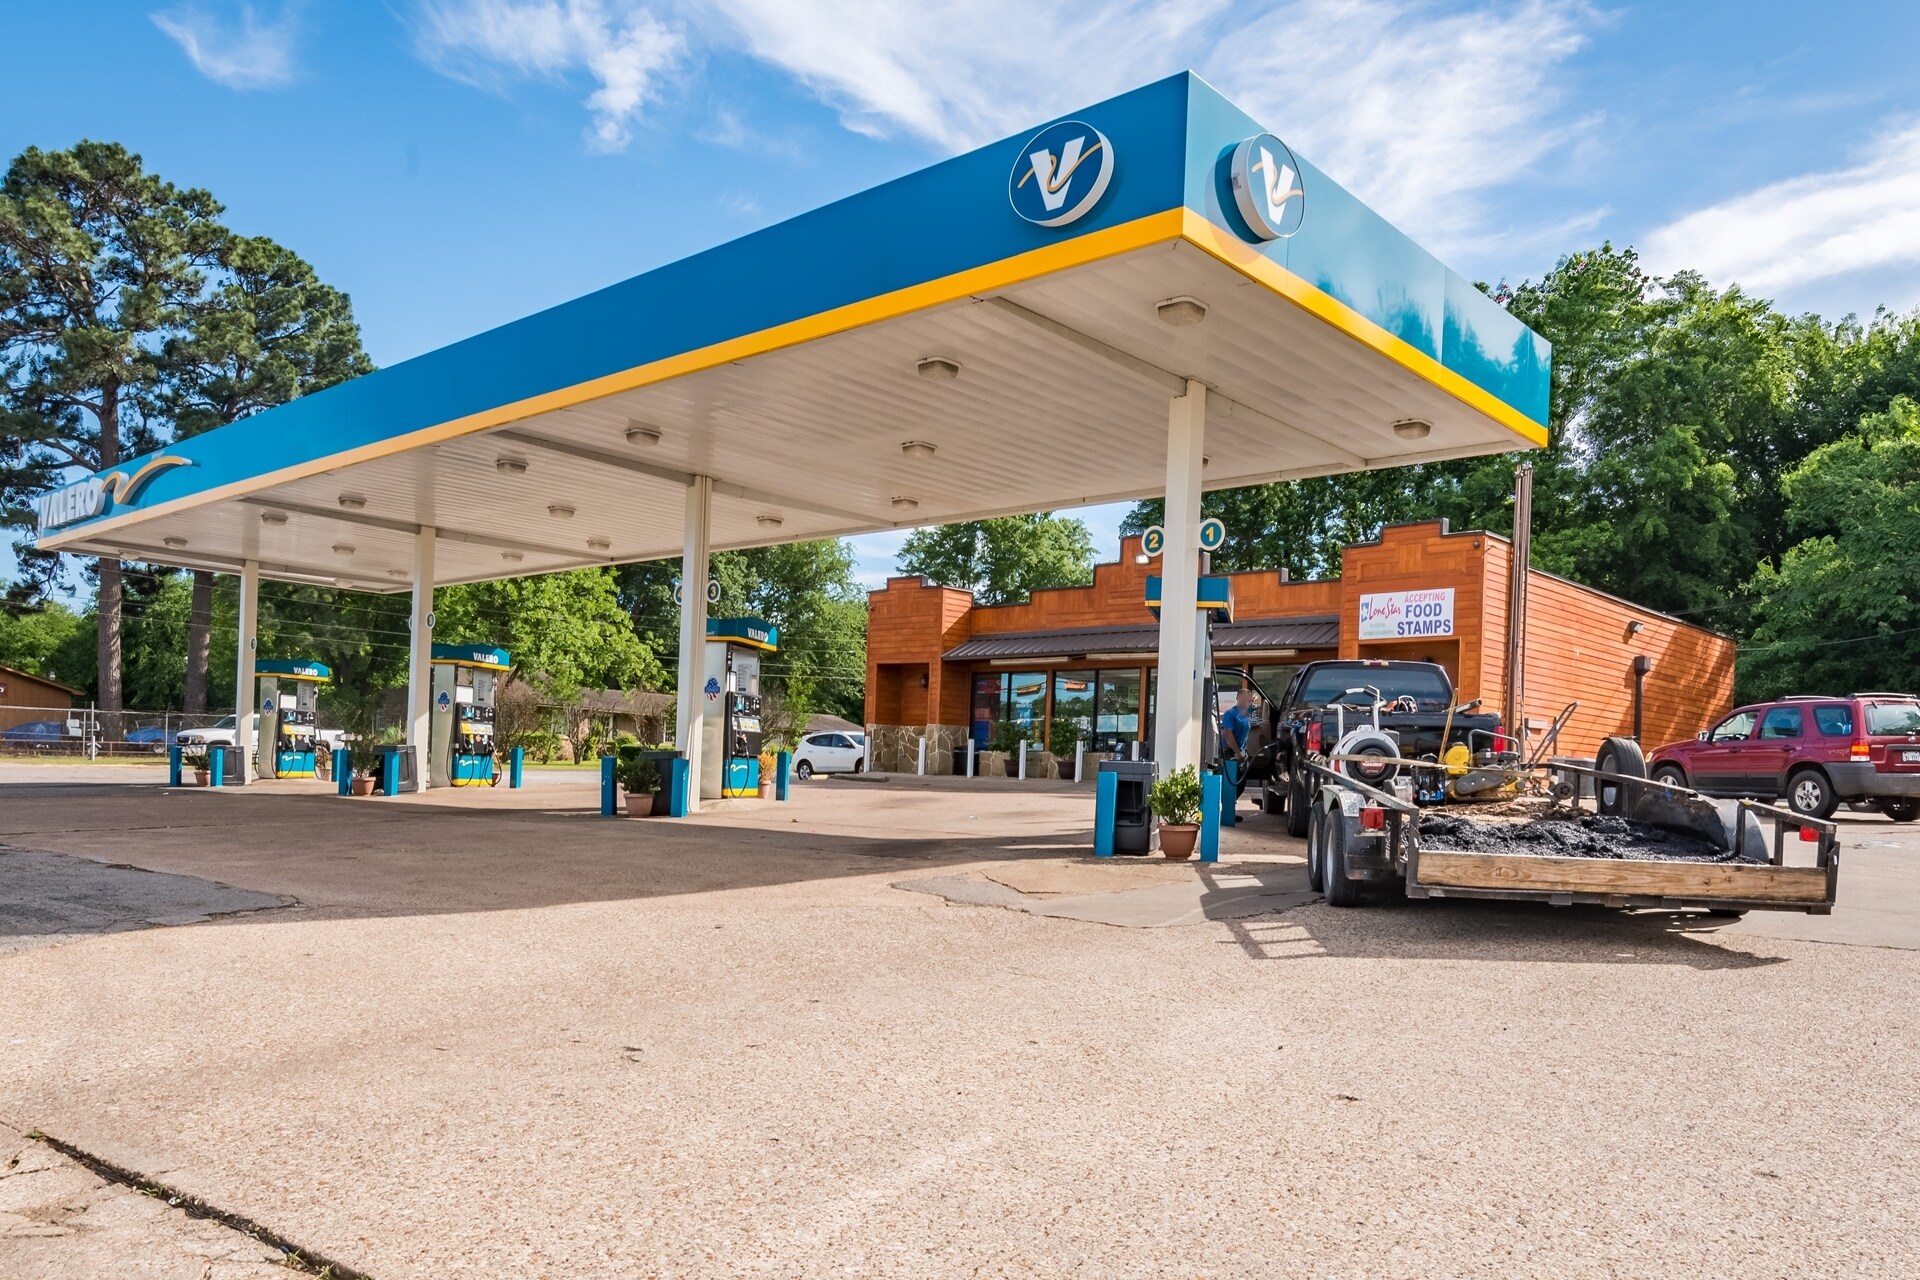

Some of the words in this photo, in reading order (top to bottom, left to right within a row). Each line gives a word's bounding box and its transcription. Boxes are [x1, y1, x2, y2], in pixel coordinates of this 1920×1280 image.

[1029, 136, 1086, 211] V
[1260, 146, 1295, 225] V
[39, 477, 103, 531] VALERO
[1148, 533, 1159, 549] 2
[1206, 526, 1214, 542] 1
[710, 585, 717, 597] 3
[1404, 592, 1446, 603] ACCEPTING
[1369, 596, 1386, 620] Lone
[1385, 597, 1401, 619] Star
[1405, 603, 1442, 618] FOOD
[747, 627, 769, 643] VALERO
[1397, 619, 1451, 635] STAMPS
[473, 652, 499, 664] VALERO
[293, 667, 318, 677] VALERO
